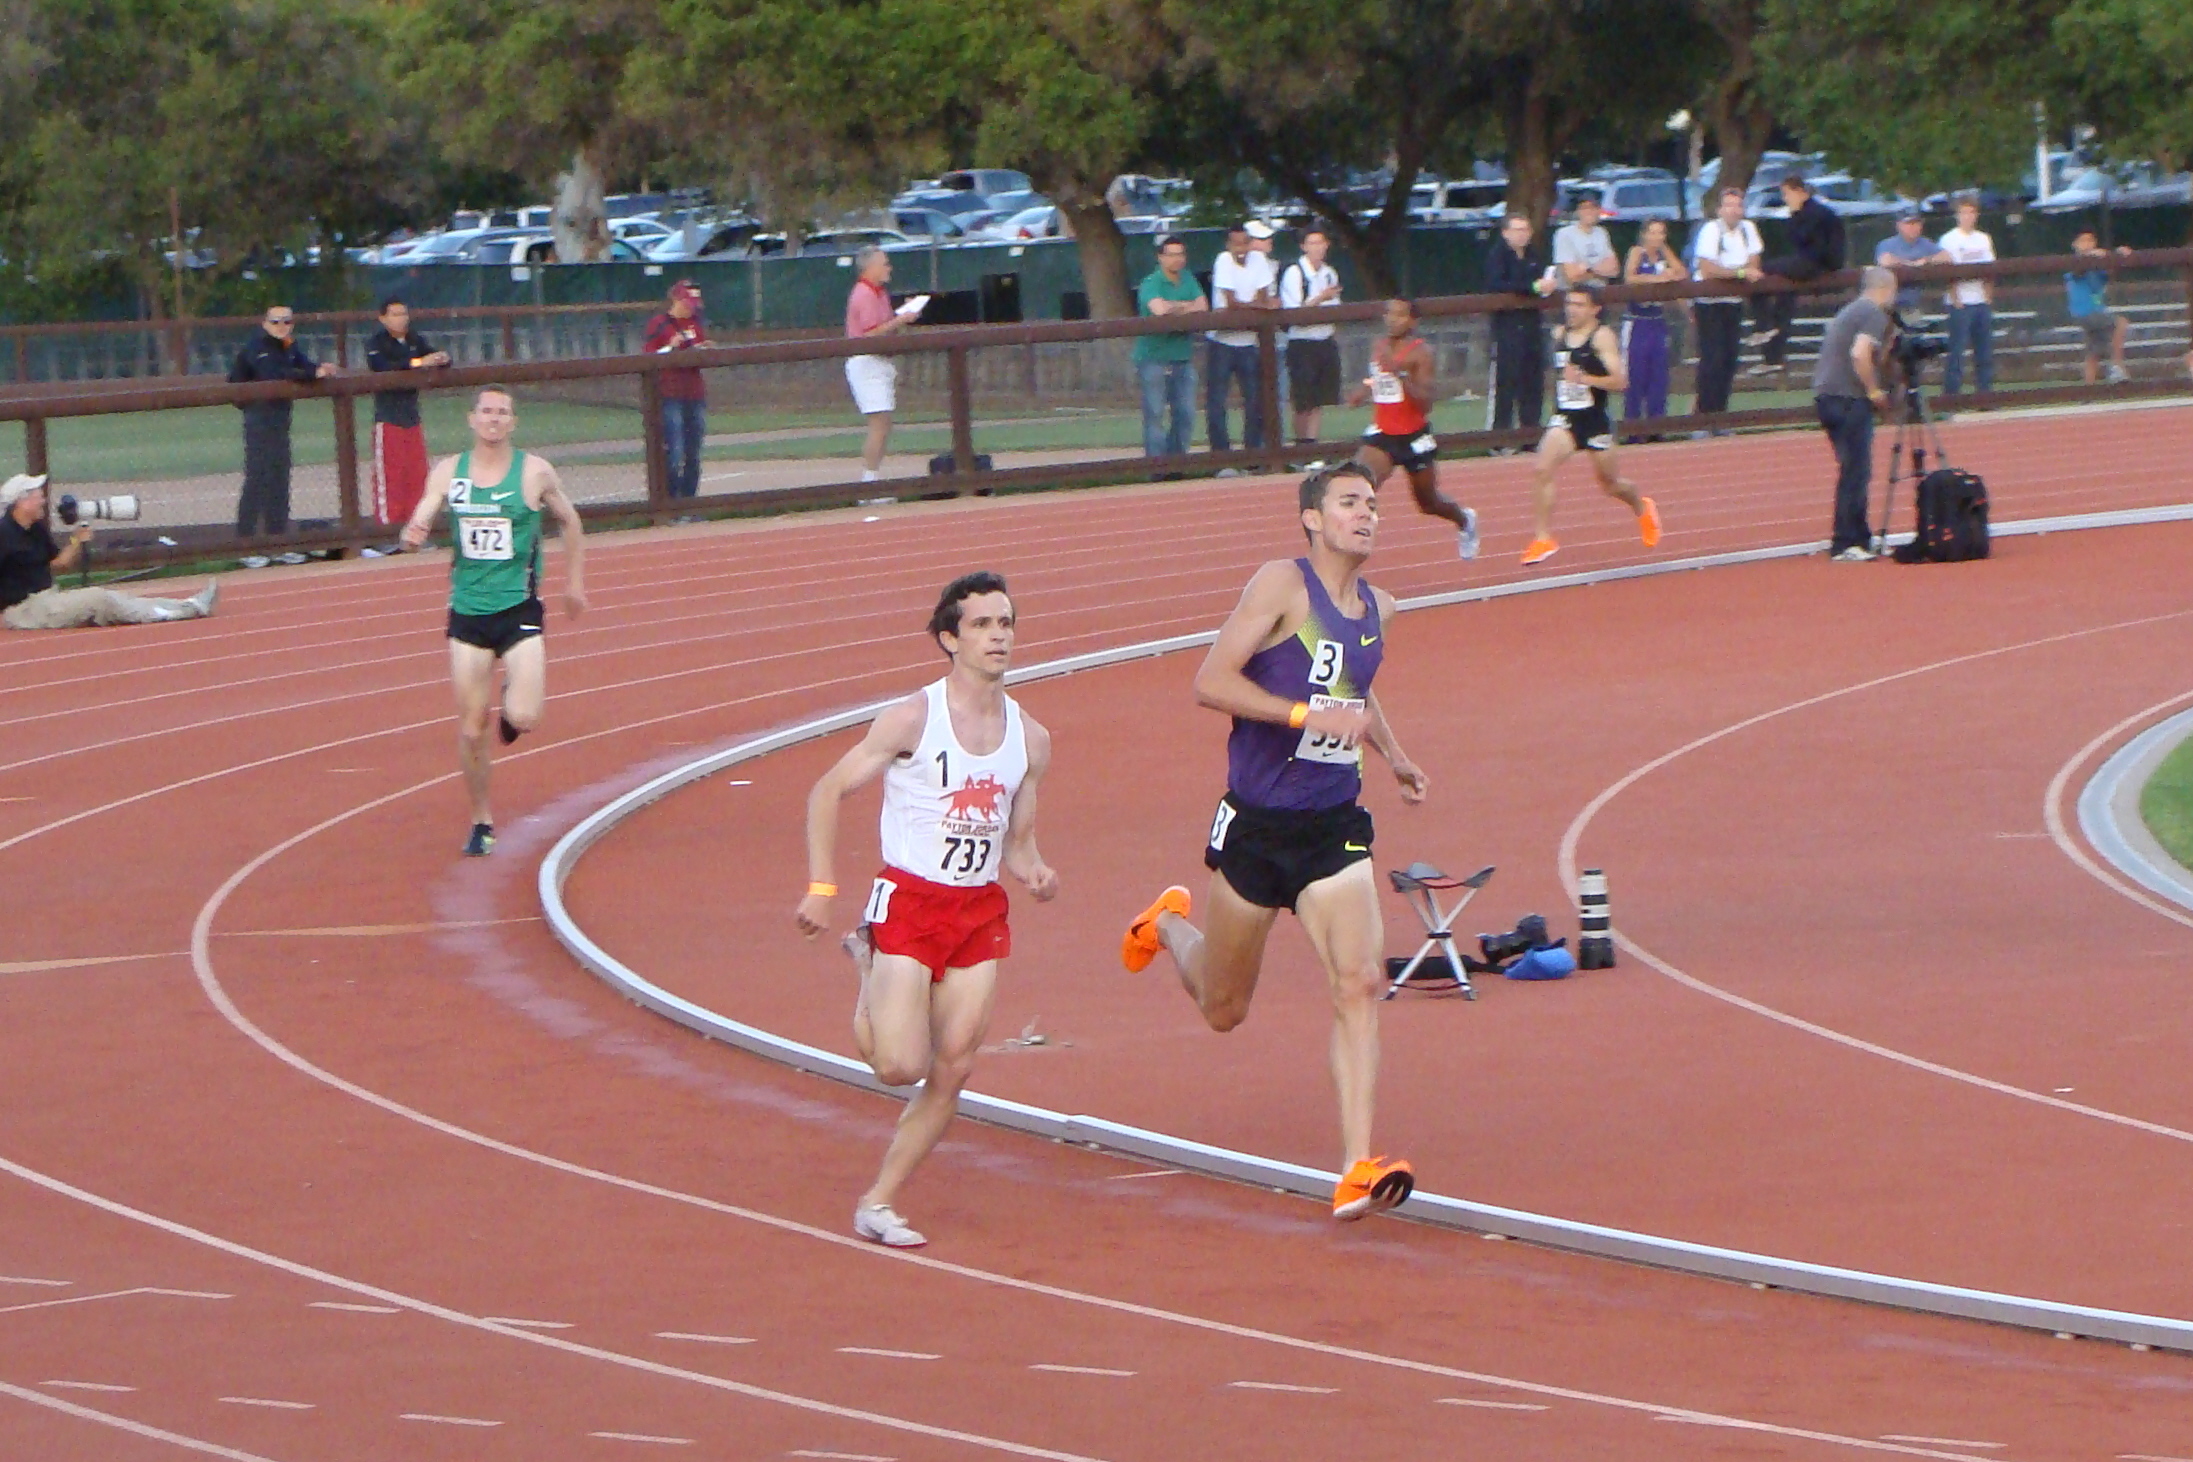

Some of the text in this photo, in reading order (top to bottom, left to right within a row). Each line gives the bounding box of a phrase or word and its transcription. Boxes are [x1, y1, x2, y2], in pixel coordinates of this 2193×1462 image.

[451, 480, 467, 504] 2
[470, 529, 504, 552] 472
[1315, 643, 1337, 682] 3
[935, 750, 949, 788] 1
[941, 820, 972, 831] PAYTON
[1211, 805, 1228, 842] 3
[940, 836, 992, 874] 733
[873, 882, 885, 919] 1
